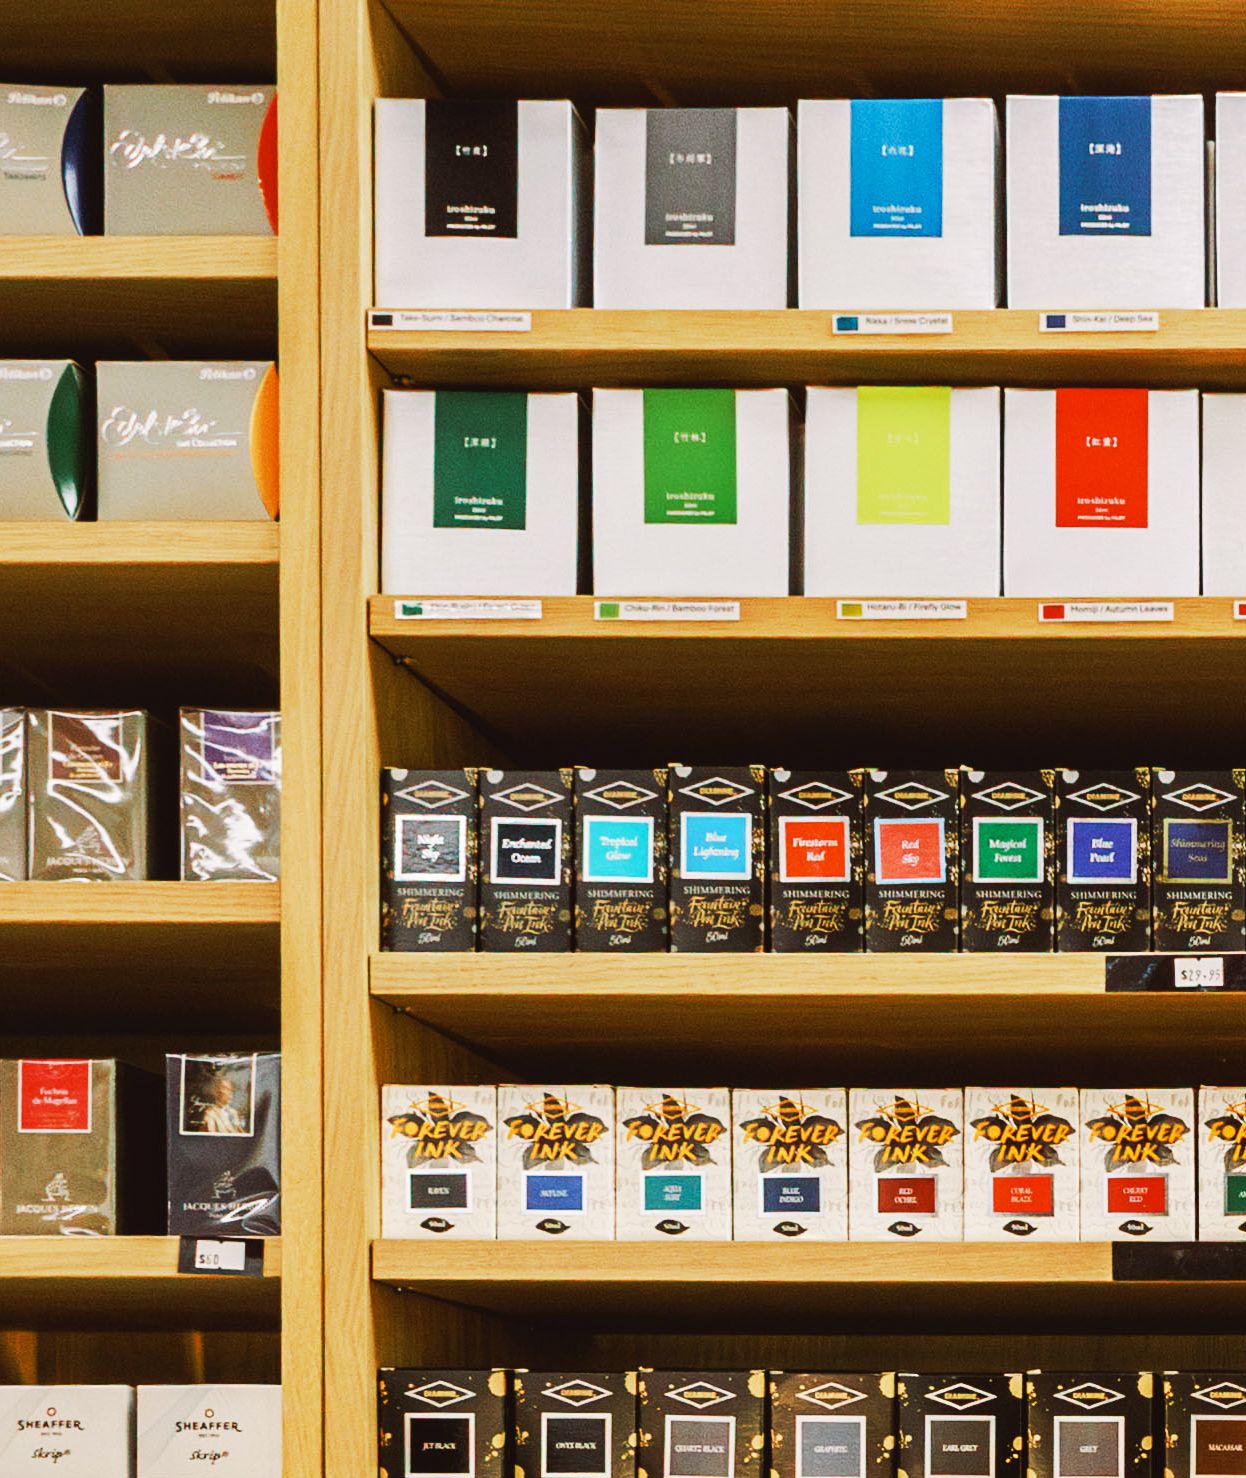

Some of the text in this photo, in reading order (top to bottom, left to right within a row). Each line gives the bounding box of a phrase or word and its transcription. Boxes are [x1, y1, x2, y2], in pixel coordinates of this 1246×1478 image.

[502, 838, 552, 850] Enchanted
[990, 838, 1026, 850] Magical
[806, 851, 824, 861] Red
[398, 889, 464, 897] SHIMMERING
[683, 886, 750, 895] SHIMMERING
[391, 1125, 489, 1141] FOREVER
[415, 1142, 462, 1160] INK
[17, 1420, 84, 1433] SHEAFFER
[175, 1421, 242, 1434] SHEAFFER
